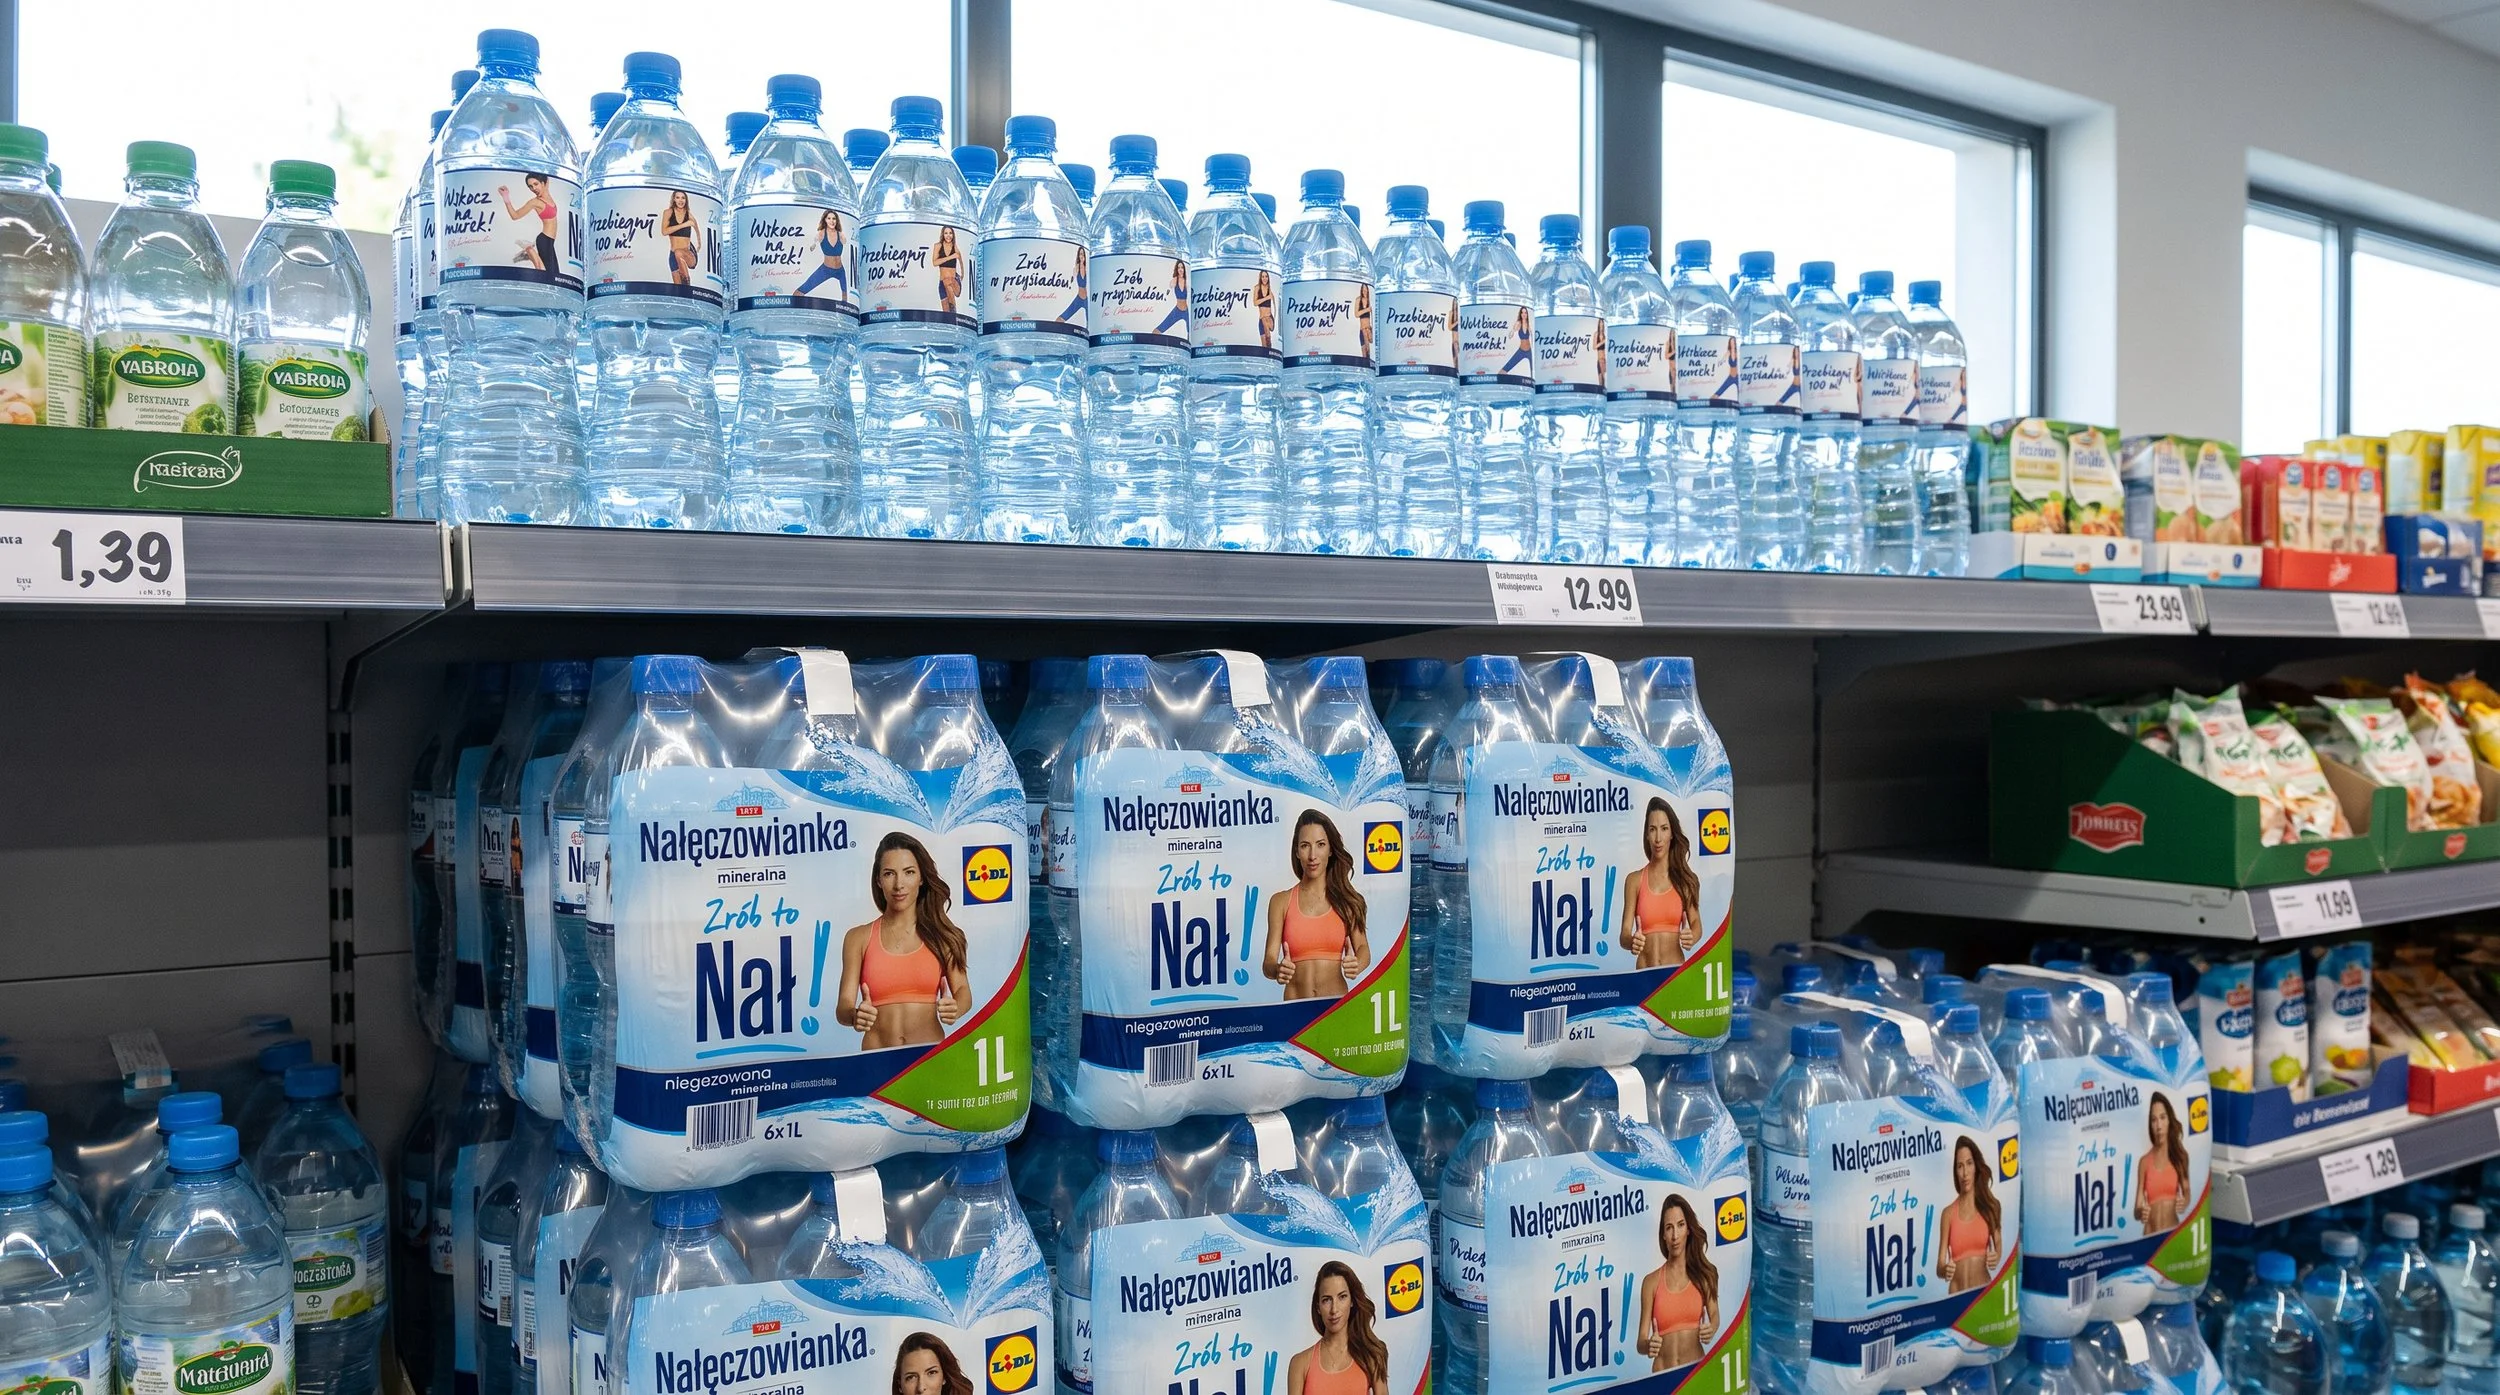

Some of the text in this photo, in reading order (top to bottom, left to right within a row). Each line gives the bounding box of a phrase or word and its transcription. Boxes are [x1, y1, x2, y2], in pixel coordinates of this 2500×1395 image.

[444, 185, 493, 208] Wskocz
[445, 211, 496, 236] murek!
[455, 209, 473, 221] na
[750, 218, 805, 238] Wskocz
[595, 237, 610, 252] 100
[765, 239, 785, 252] na
[751, 247, 804, 266] murek!
[1016, 253, 1048, 271] Zrób
[868, 267, 888, 282] 100
[1194, 307, 1212, 319] 100
[1295, 317, 1314, 329] 100
[1396, 326, 1415, 339] 100
[1541, 348, 1560, 359] 100
[1615, 357, 1633, 368] 100
[52, 529, 172, 588] 1,39
[1564, 577, 1633, 611] 12.99
[639, 811, 849, 867] Nałęczowianka
[1167, 838, 1223, 853] mineralna
[1535, 844, 1596, 875] Zrób to
[717, 868, 787, 886] mineralna
[1157, 860, 1233, 895] Zrób to
[703, 893, 800, 935] Zrób to
[1703, 961, 1729, 1001] 1L
[1370, 989, 1402, 1034] 1L
[1568, 1026, 1595, 1041] 6x1L
[973, 1035, 1014, 1087] 1L
[1202, 1063, 1235, 1081] 6x1L
[763, 1121, 803, 1141] 6x1L
[1902, 1189, 1918, 1211] to
[1553, 1253, 1615, 1293] Zrób to
[1185, 1304, 1242, 1328] mineralna
[1174, 1332, 1221, 1377] Zrób
[1229, 1332, 1254, 1365] to
